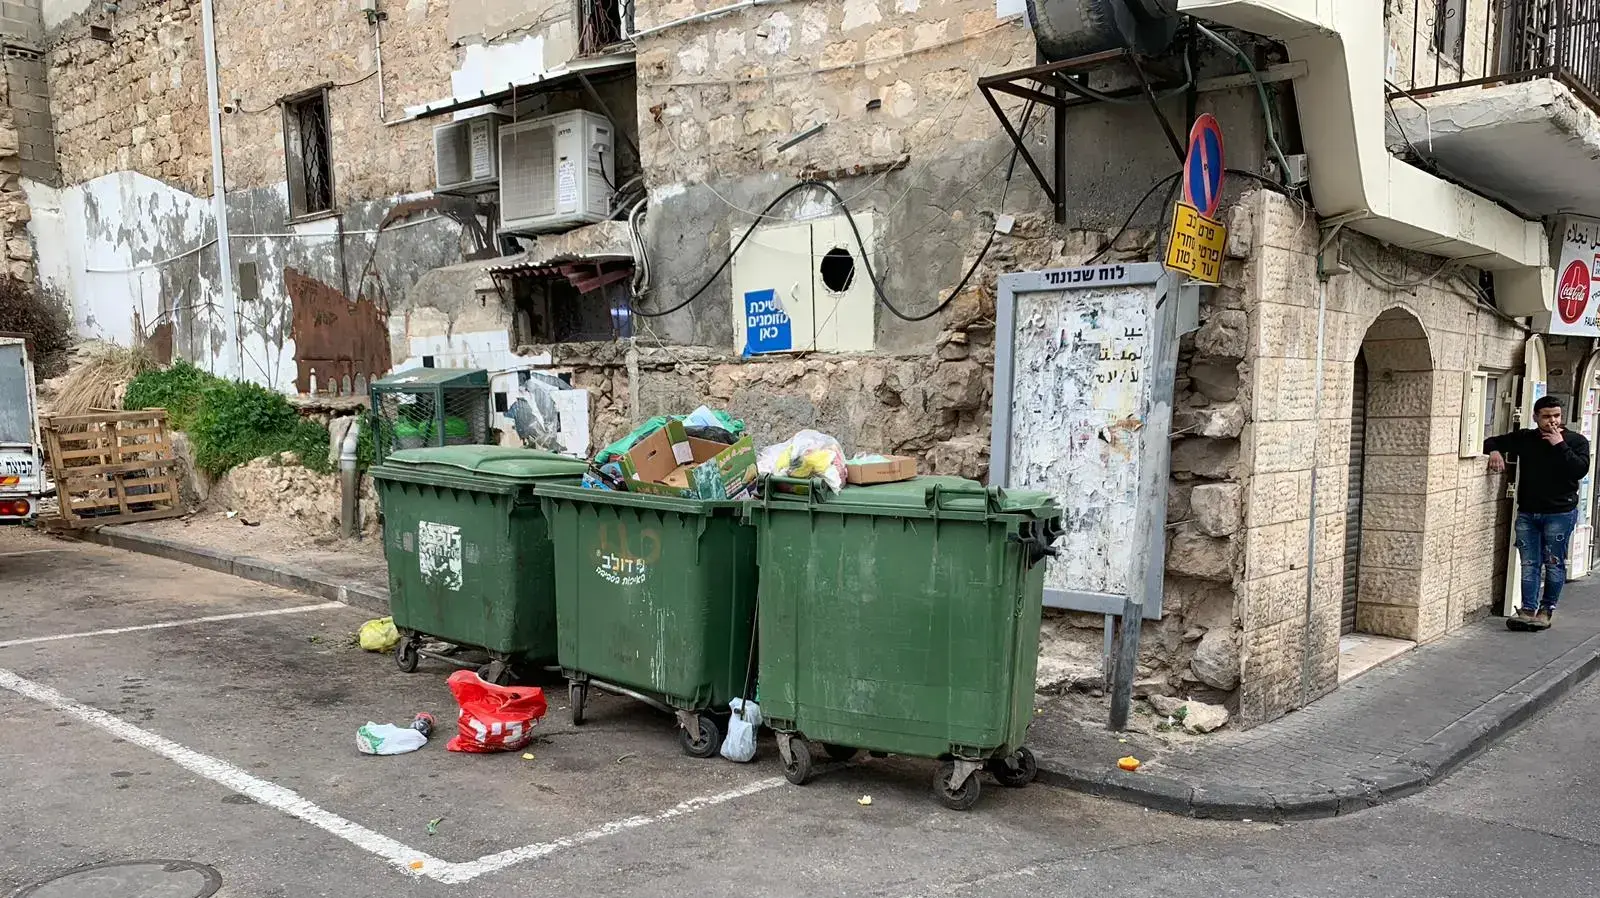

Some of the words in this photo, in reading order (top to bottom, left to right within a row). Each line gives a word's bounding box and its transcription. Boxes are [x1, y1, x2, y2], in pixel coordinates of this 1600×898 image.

[1197, 224, 1215, 241] פרט
[1175, 248, 1191, 264] טון
[1198, 244, 1219, 262] פרטי
[1191, 258, 1197, 271] 5
[1201, 261, 1214, 276] עד
[1044, 268, 1095, 284] שכונתי
[1098, 265, 1125, 281] לוח
[759, 326, 778, 342] כאן
[601, 552, 634, 573] דולב
